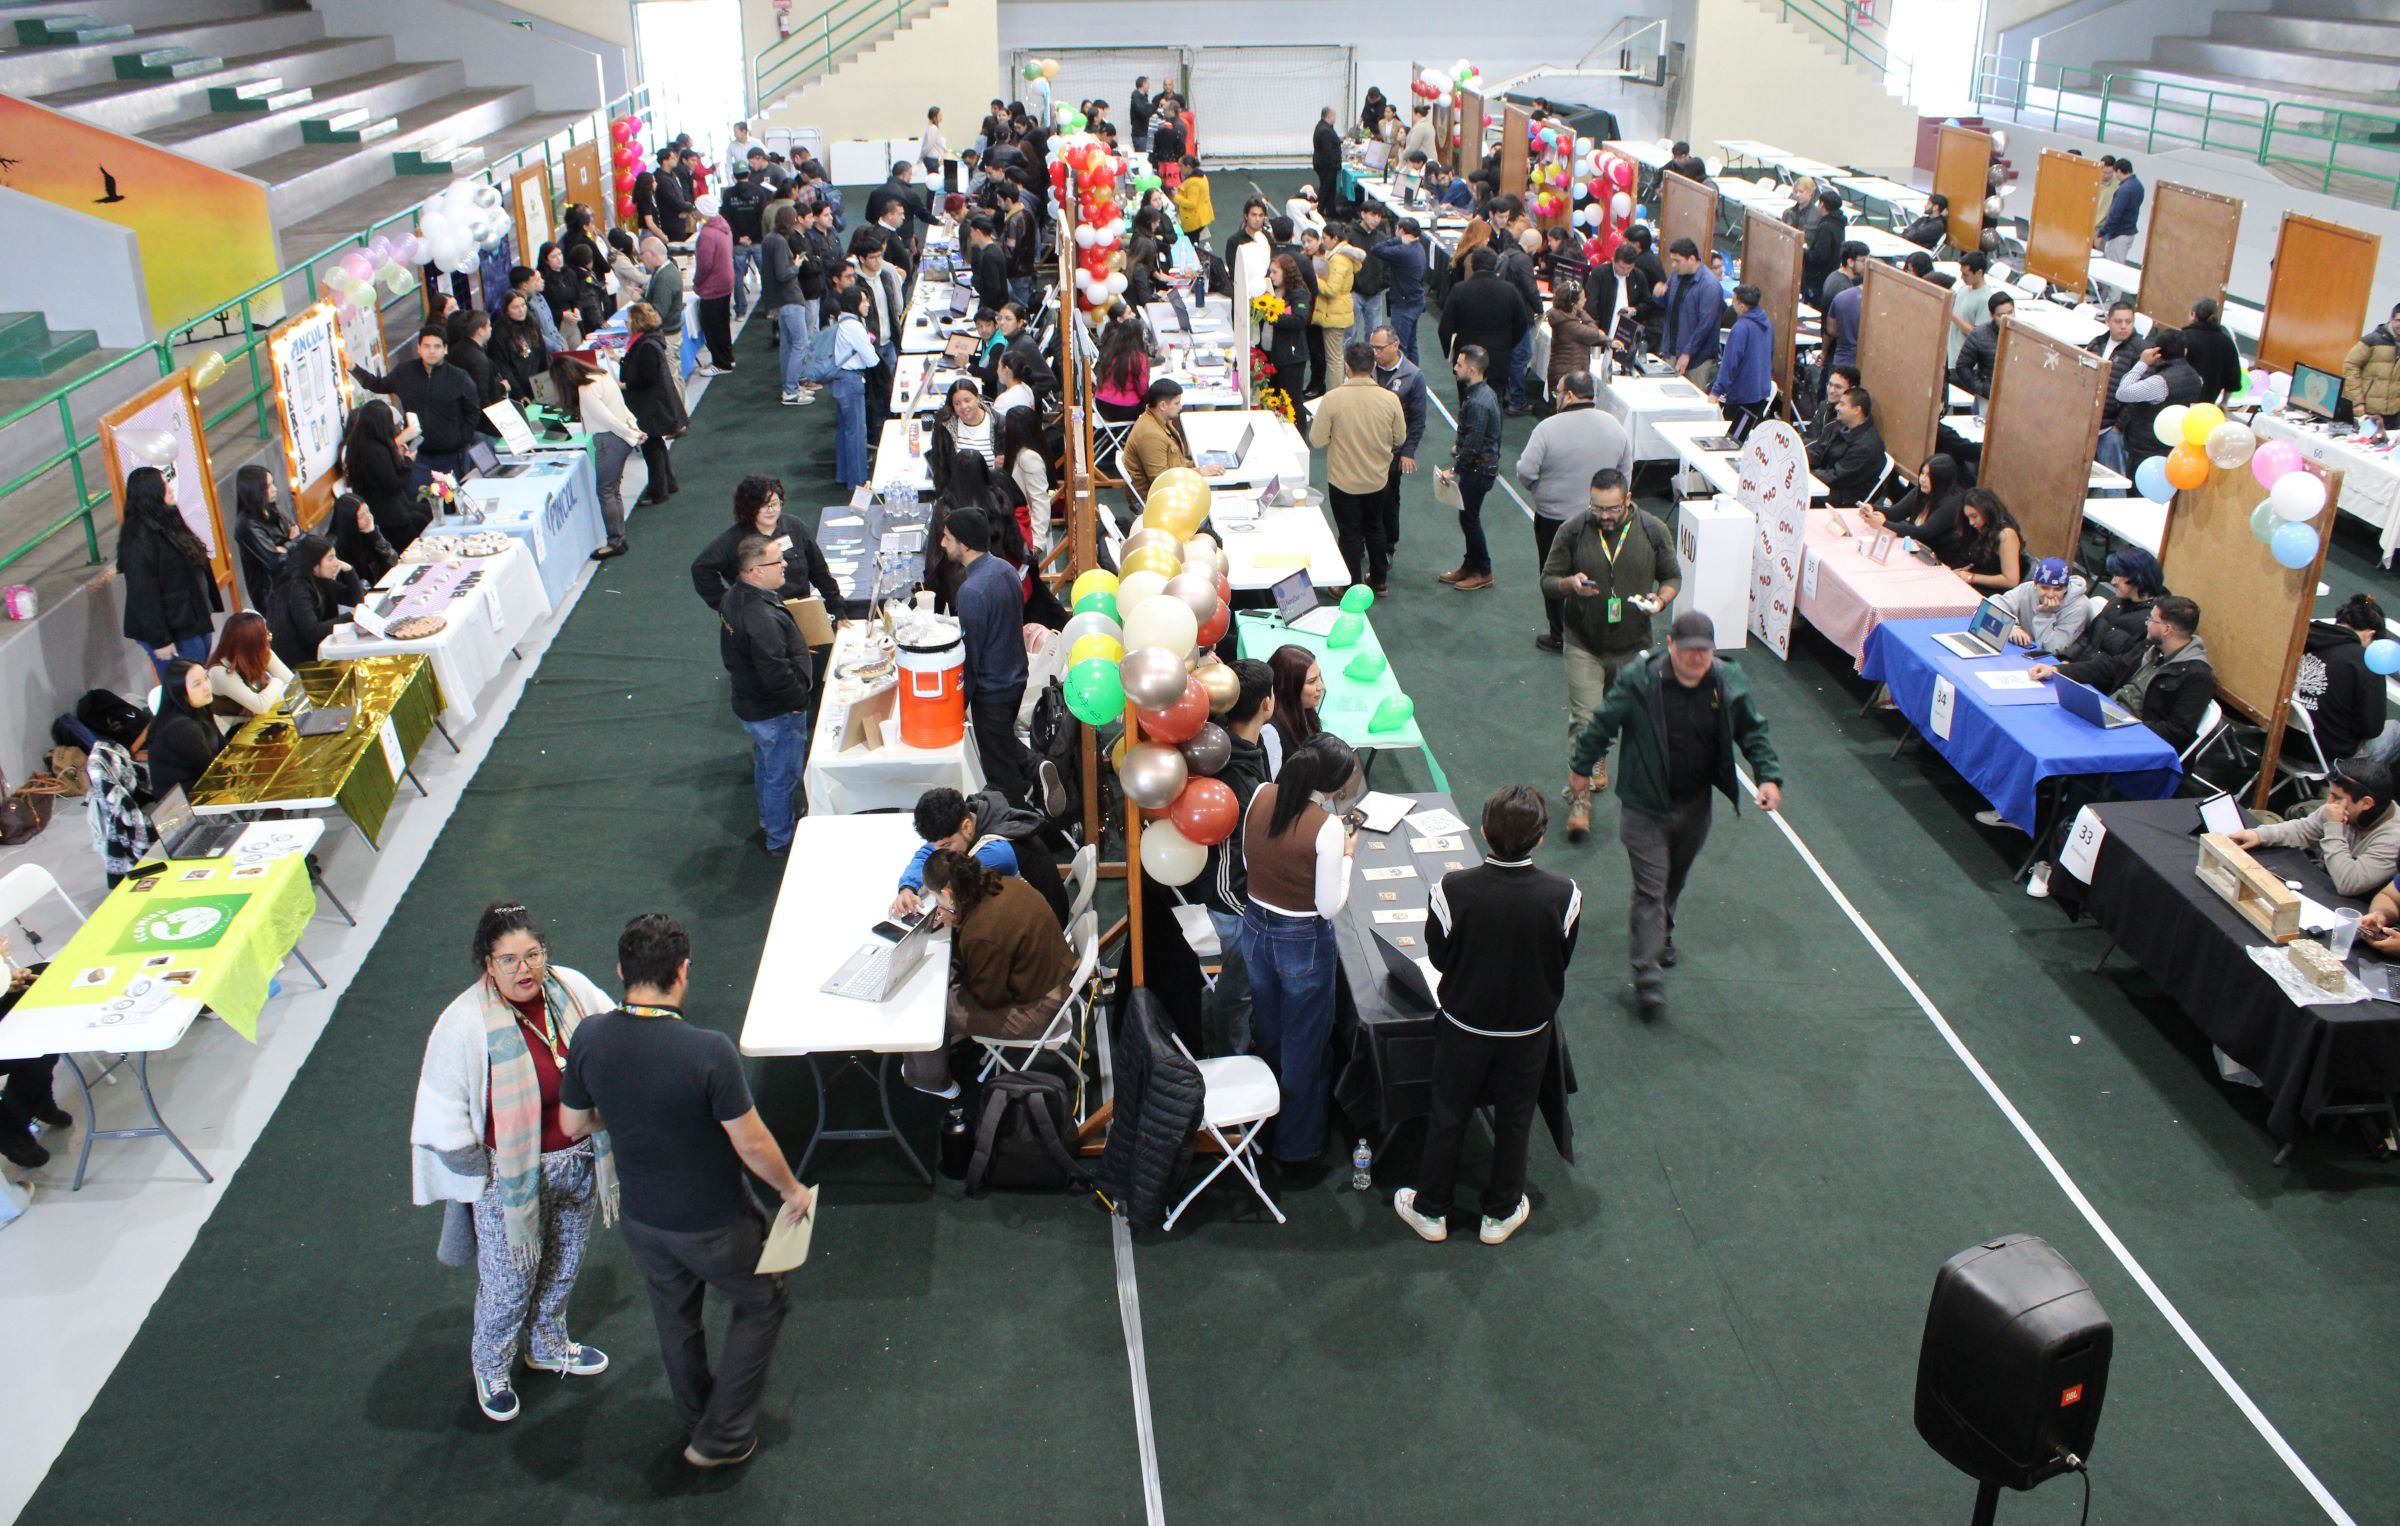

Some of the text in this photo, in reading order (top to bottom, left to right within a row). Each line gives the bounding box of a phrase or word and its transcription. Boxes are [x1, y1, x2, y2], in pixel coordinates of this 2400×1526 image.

[1775, 432, 1790, 449] MAD
[1755, 446, 1769, 466] MAD
[1743, 479, 1756, 492] MAD
[1763, 486, 1776, 504] MAD
[1779, 520, 1793, 535] MAD
[1680, 523, 1696, 563] MAD
[1761, 530, 1772, 555] MAD
[1781, 557, 1794, 581] MAD
[1936, 690, 1947, 706] 34
[2079, 825, 2094, 845] 33
